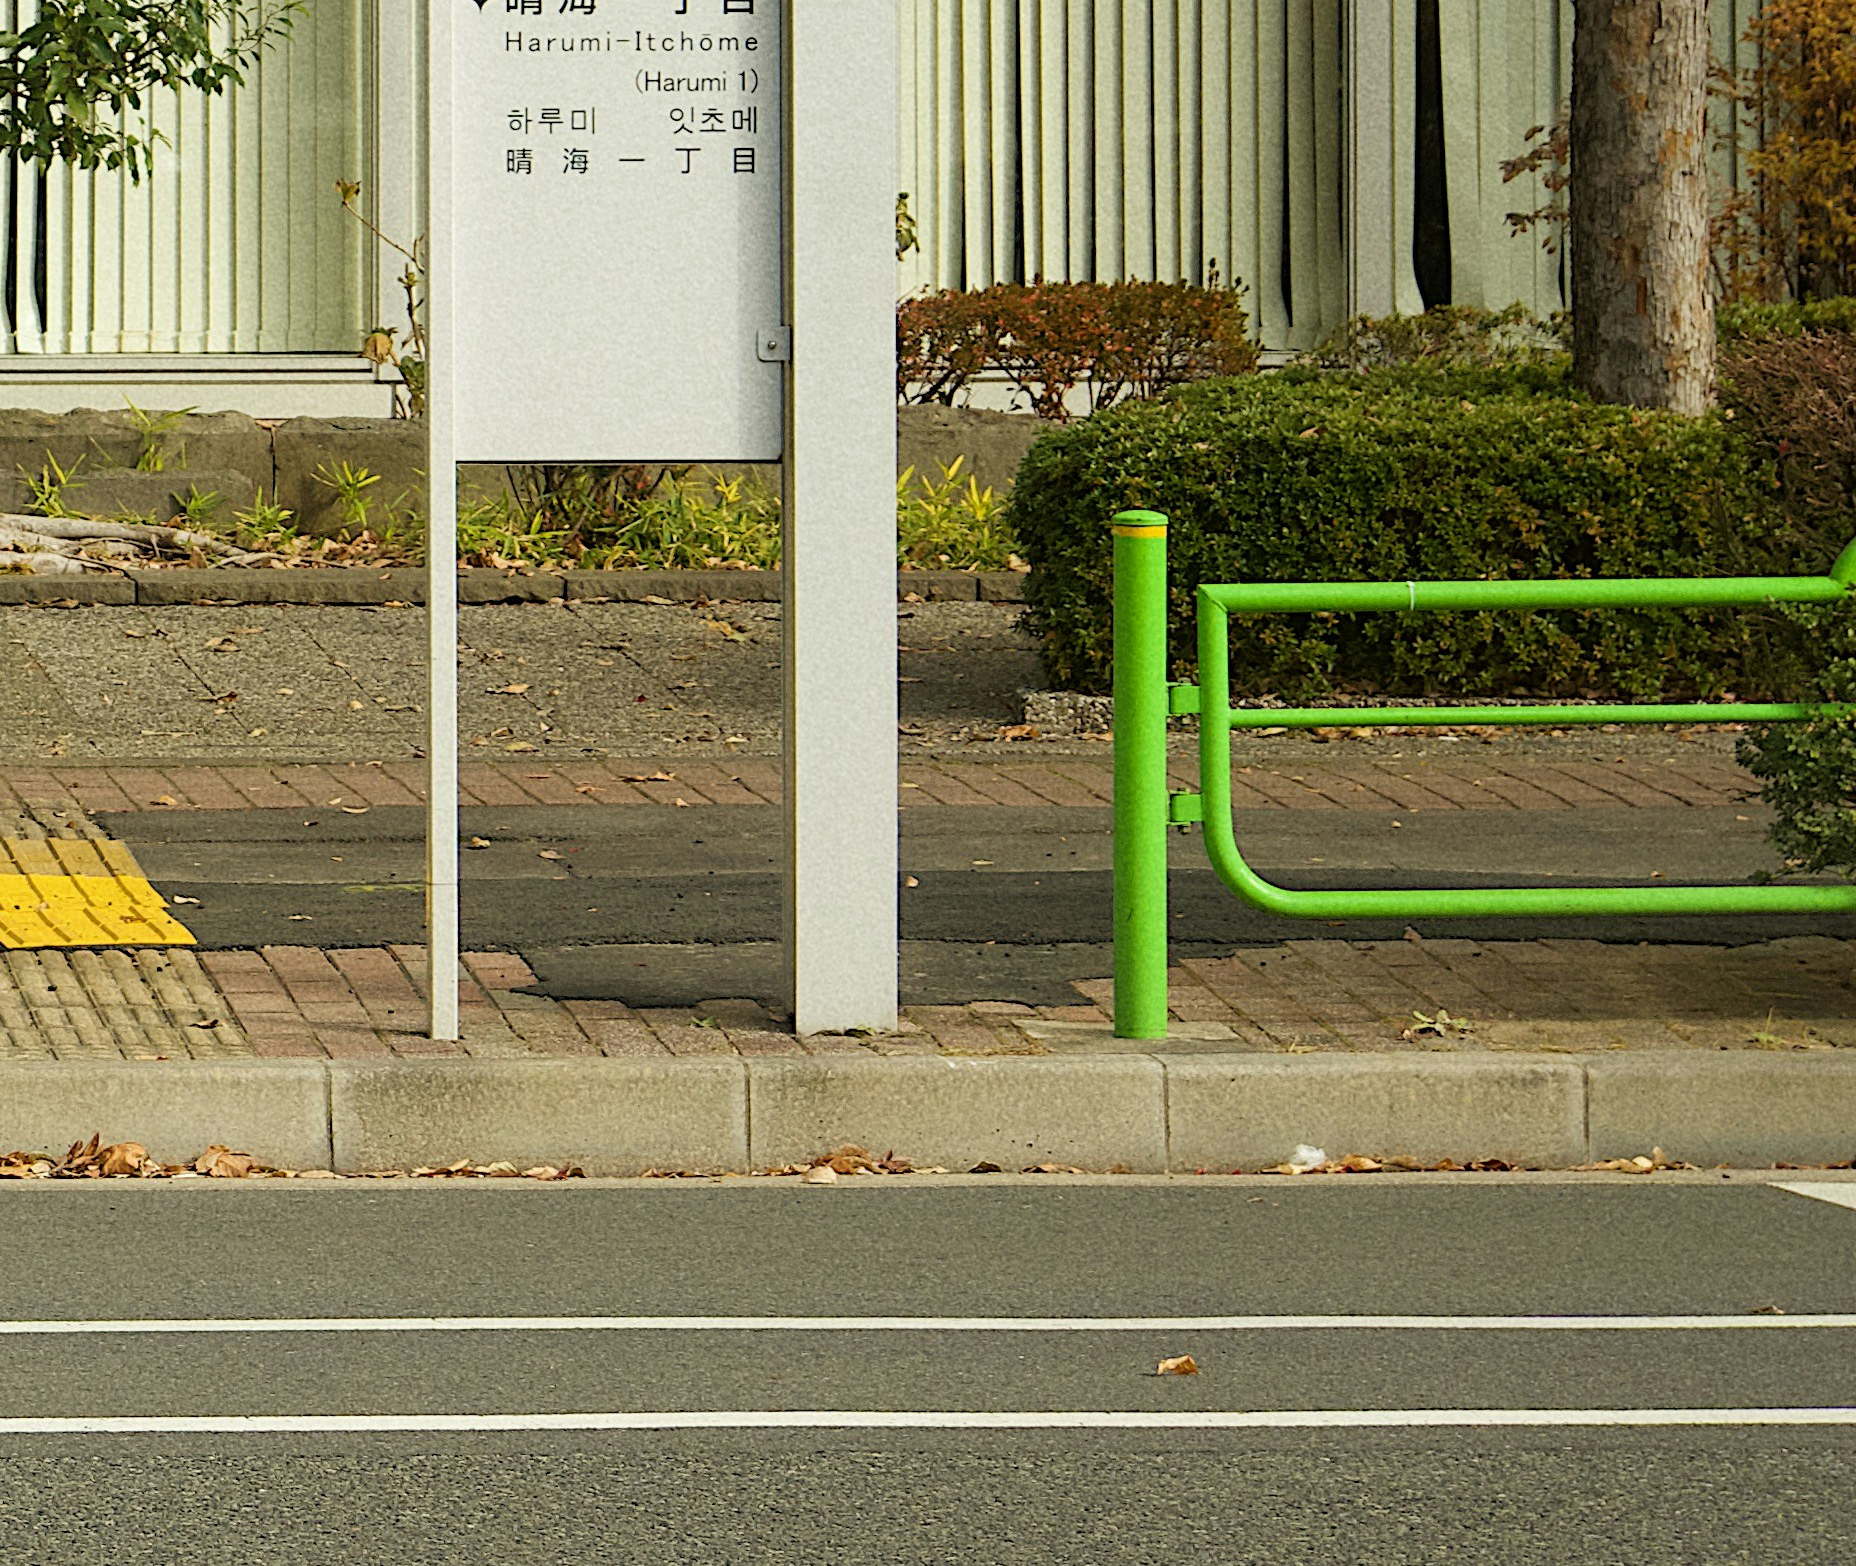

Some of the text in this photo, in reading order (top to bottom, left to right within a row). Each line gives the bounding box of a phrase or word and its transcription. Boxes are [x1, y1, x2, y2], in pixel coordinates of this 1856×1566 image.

[505, 31, 759, 52] Harumi-Itchōme
[634, 68, 759, 93] (Harumi 1)
[507, 106, 758, 135] 하루미 잇초메
[506, 147, 757, 175] 晴海一丁目
